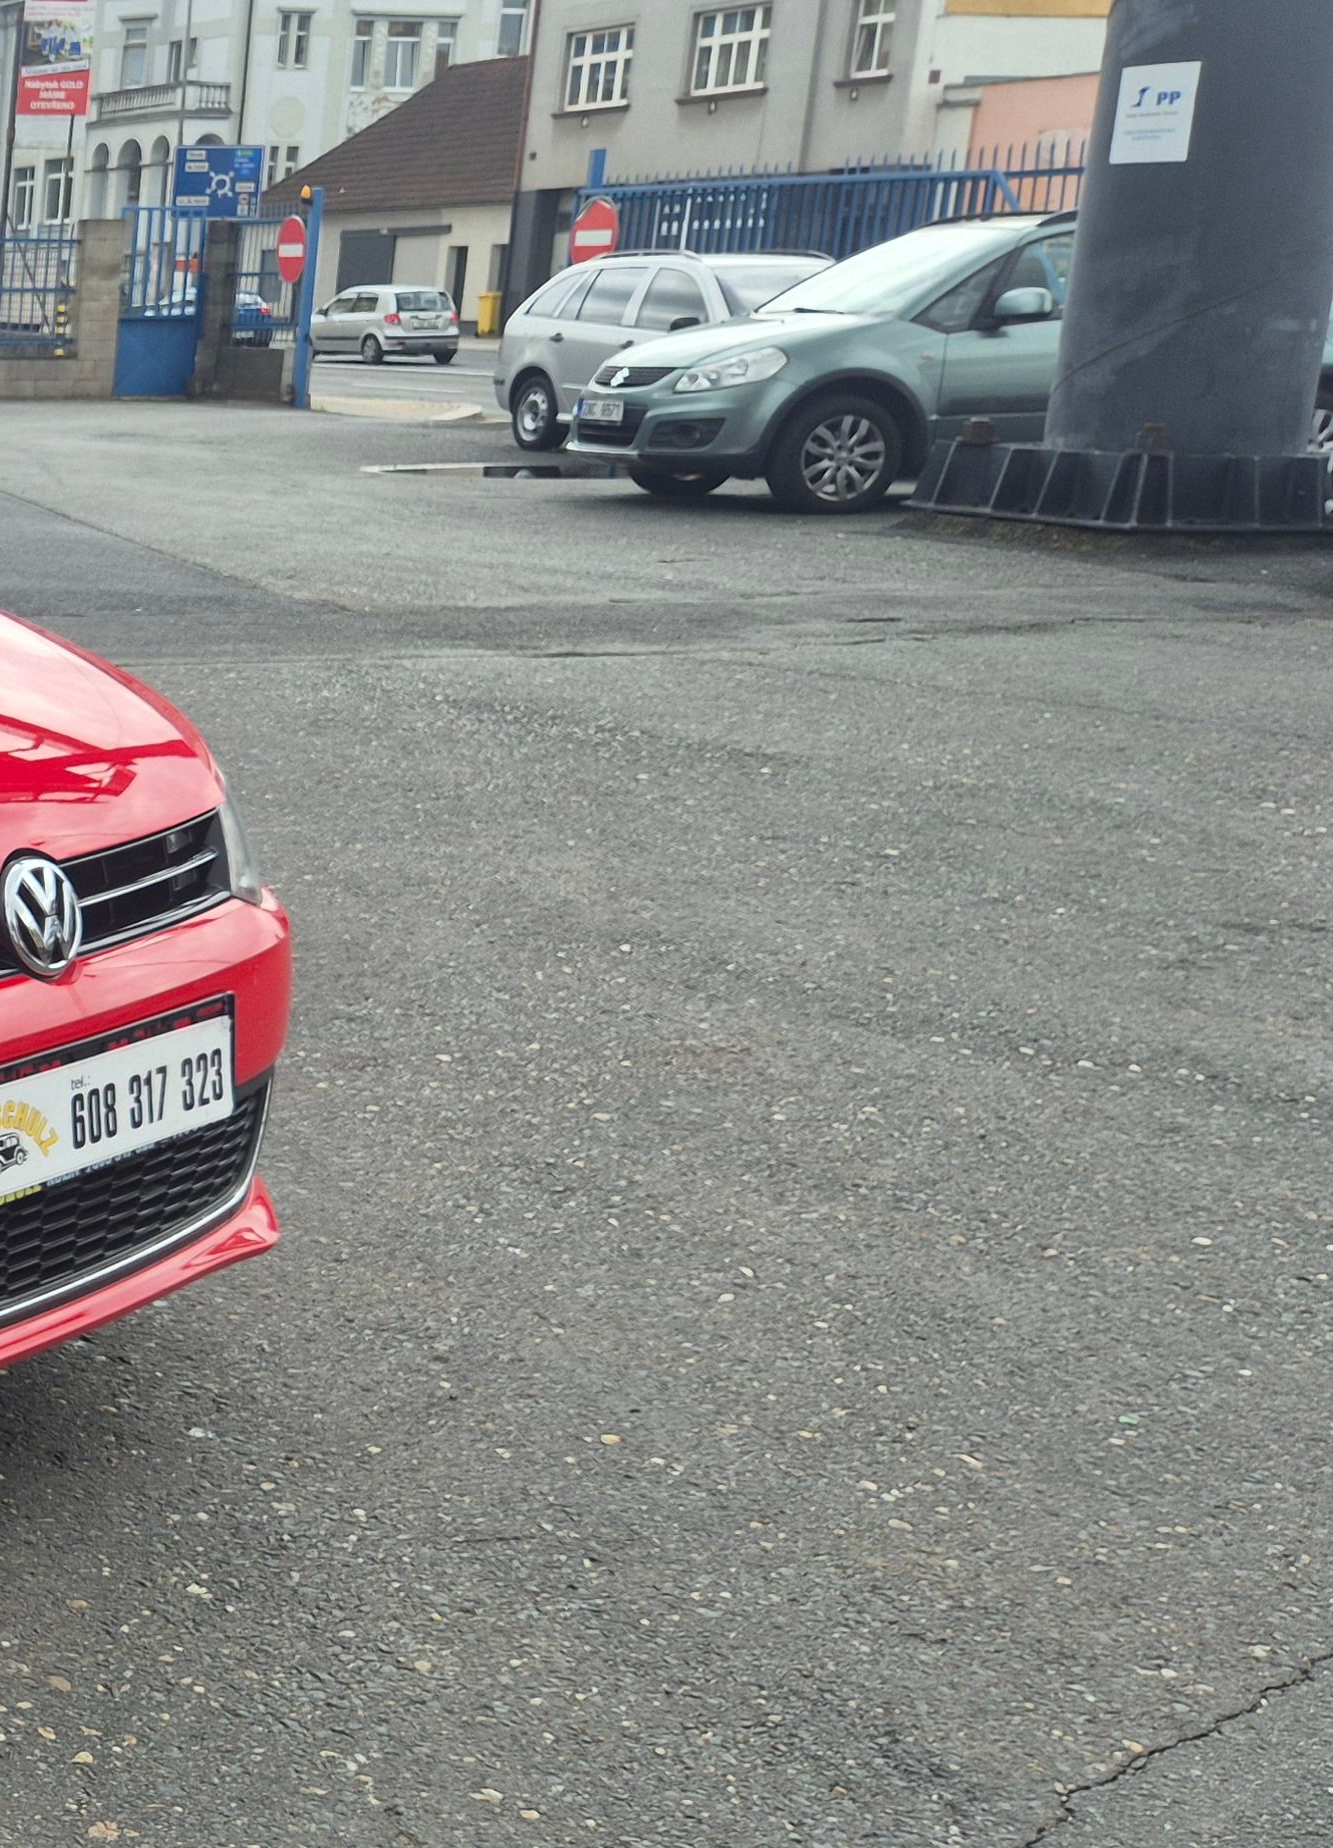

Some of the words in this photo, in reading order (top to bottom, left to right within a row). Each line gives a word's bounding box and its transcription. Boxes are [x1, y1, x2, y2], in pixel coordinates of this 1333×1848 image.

[71, 1082, 118, 1150] 608
[129, 1064, 167, 1130] 317
[181, 1047, 224, 1112] 323
